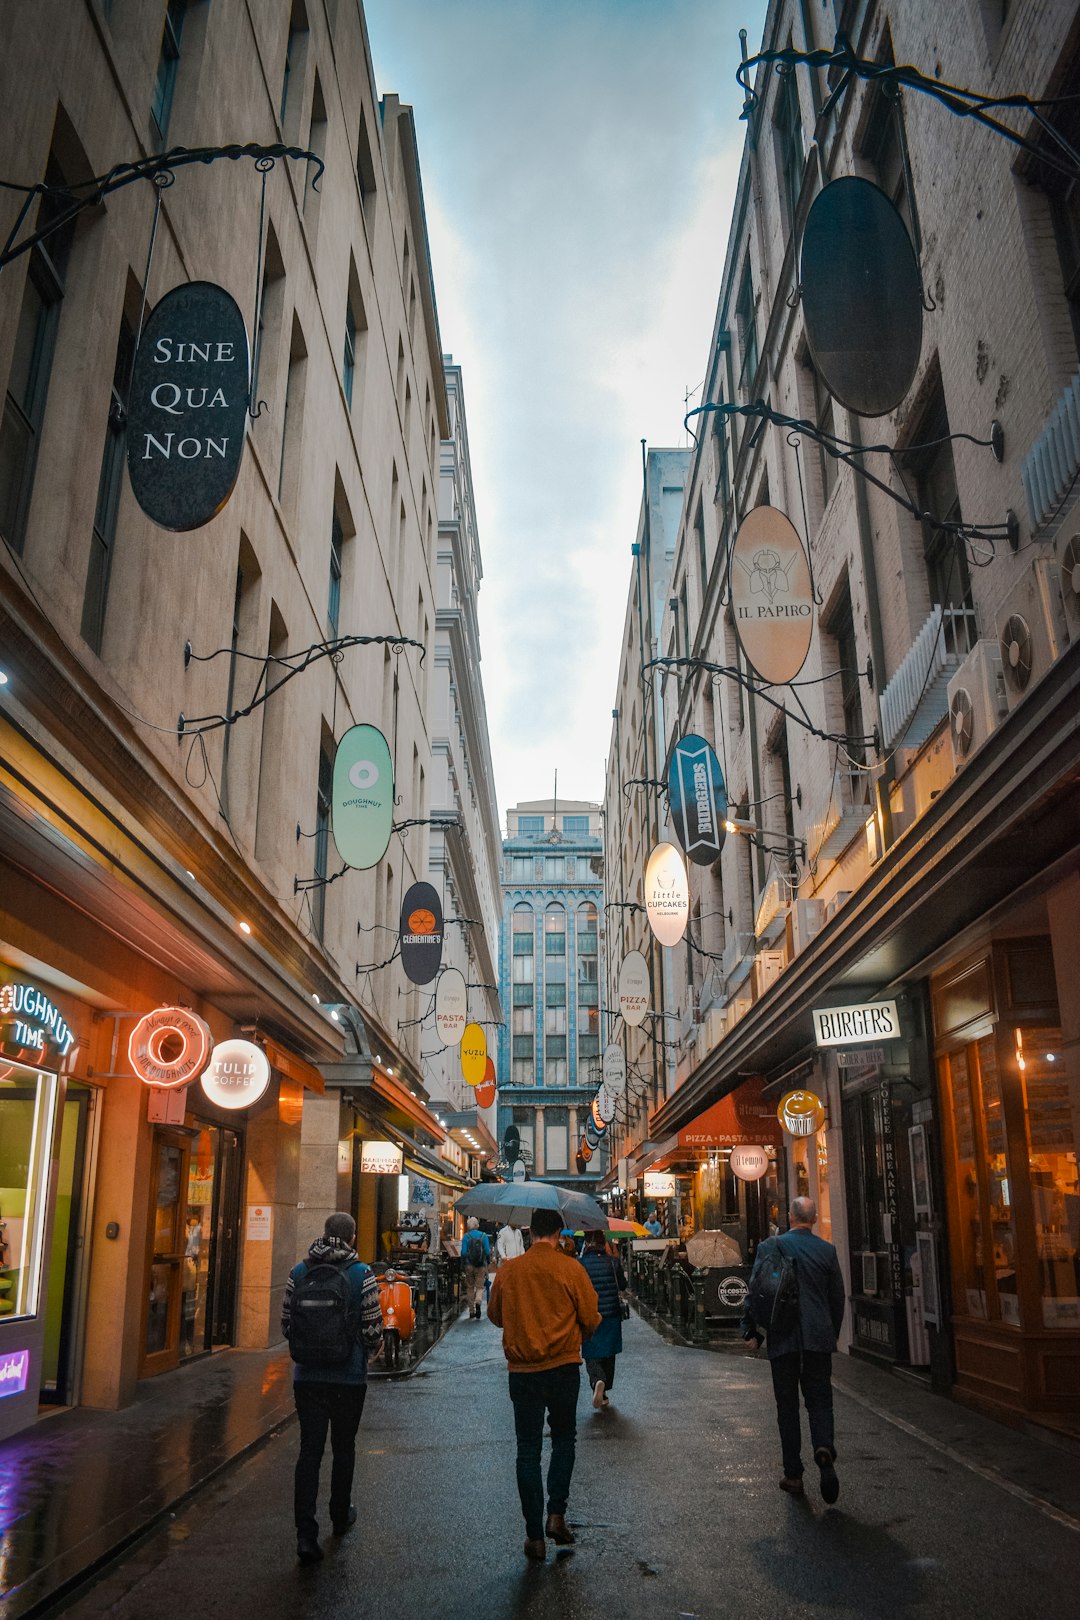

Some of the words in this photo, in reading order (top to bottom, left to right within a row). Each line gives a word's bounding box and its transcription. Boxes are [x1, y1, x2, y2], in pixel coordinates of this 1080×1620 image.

[153, 338, 236, 364] SINE
[150, 382, 230, 415] QUA
[141, 432, 230, 460] NON
[737, 606, 753, 619] IL
[757, 604, 811, 618] PAPIRO
[342, 798, 382, 809] DOUGHNUT
[693, 762, 713, 834] BURGERS
[653, 890, 681, 899] little
[620, 996, 647, 1004] PIZZA
[0, 984, 74, 1056] OUGHNUT
[145, 1015, 174, 1032] Always
[181, 1020, 201, 1038] good
[437, 1014, 465, 1022] PASTA
[819, 1007, 893, 1039] BURGERS
[15, 1020, 45, 1050] TIME
[464, 1049, 485, 1057] YUZU
[150, 1058, 196, 1079] DOUGHNUTS
[214, 1061, 257, 1074] TULIP
[213, 1075, 256, 1087] COFFEE
[880, 1081, 892, 1135] COFFEE
[685, 1134, 713, 1143] PIZZA
[719, 1134, 749, 1143] PASTA
[755, 1134, 775, 1143] BAR
[361, 1163, 401, 1173] PASTA
[736, 1154, 742, 1167] il
[743, 1155, 763, 1168] tempo
[885, 1143, 897, 1226] BREAKFAST
